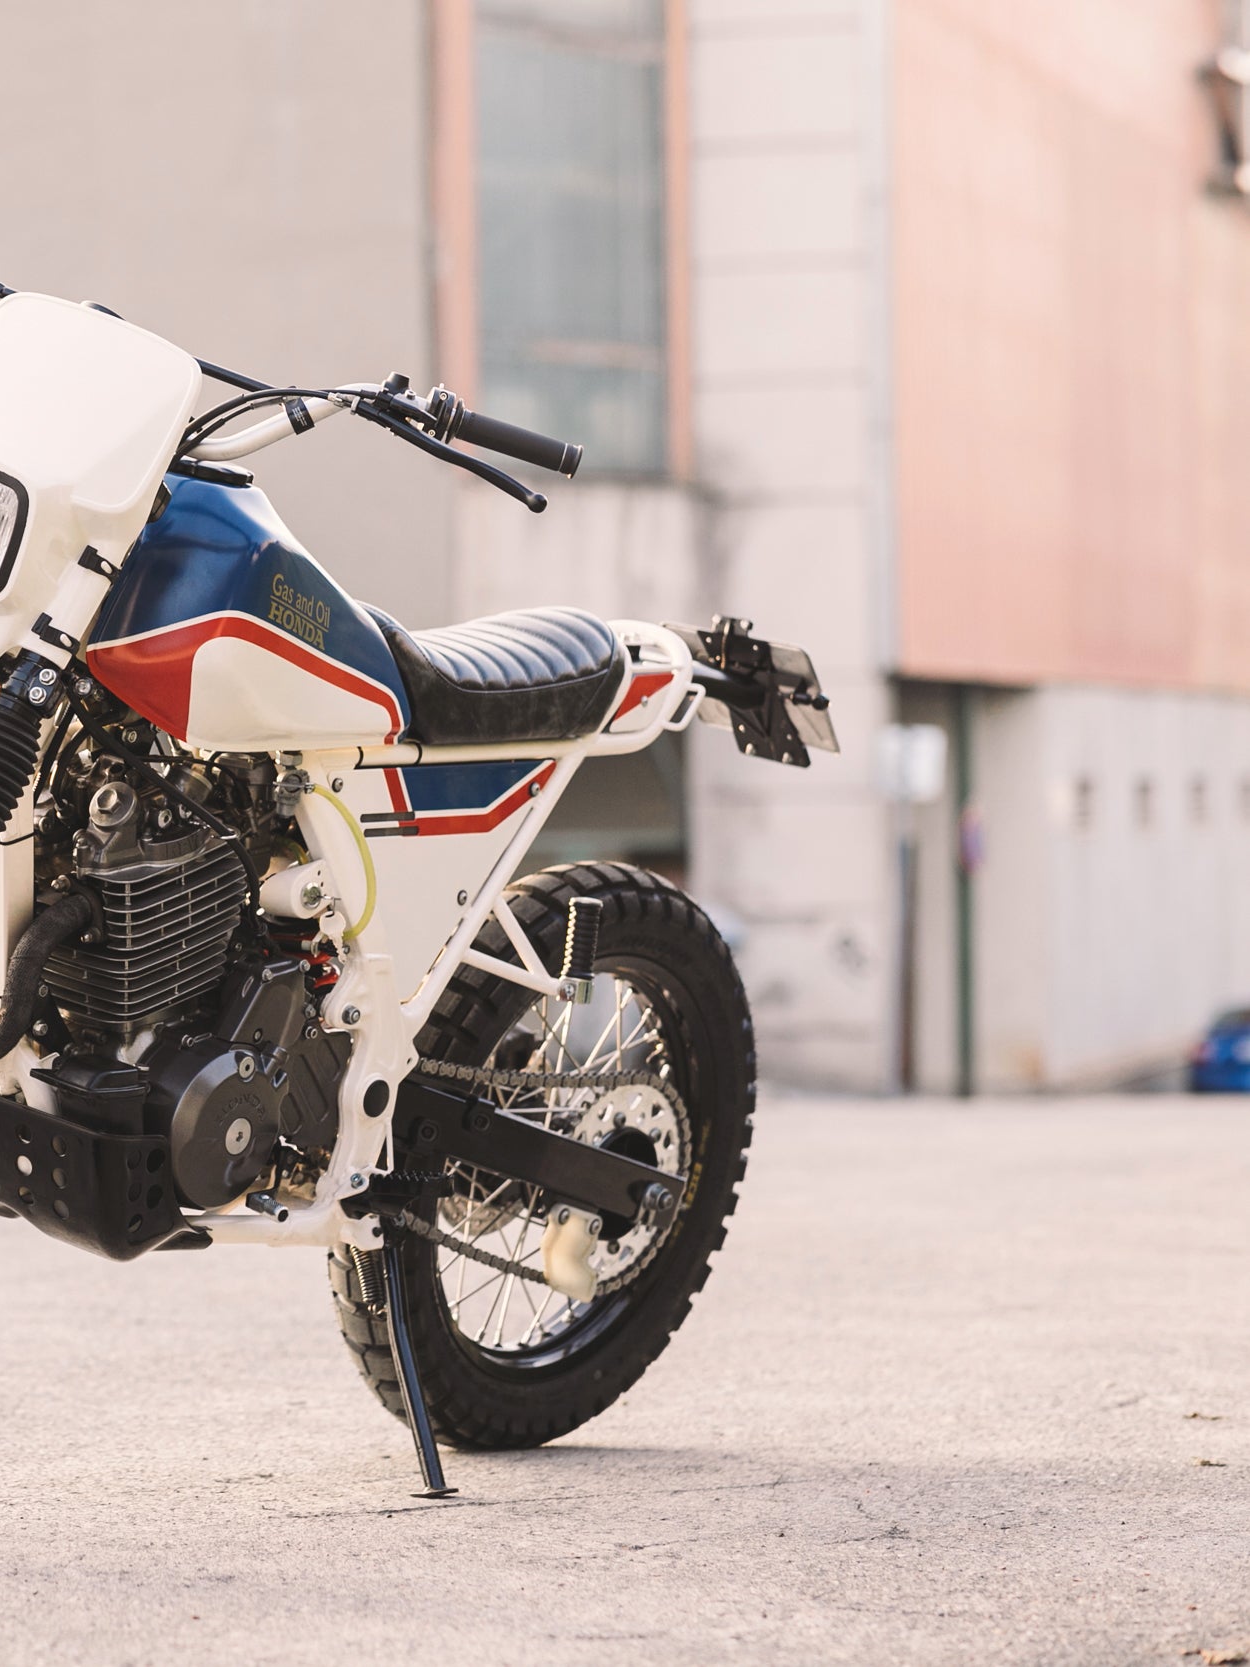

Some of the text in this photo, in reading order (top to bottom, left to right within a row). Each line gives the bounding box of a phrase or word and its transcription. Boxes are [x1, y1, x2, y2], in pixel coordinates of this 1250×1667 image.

[268, 602, 325, 650] HONDA
[272, 573, 330, 628] Gas and Oil
